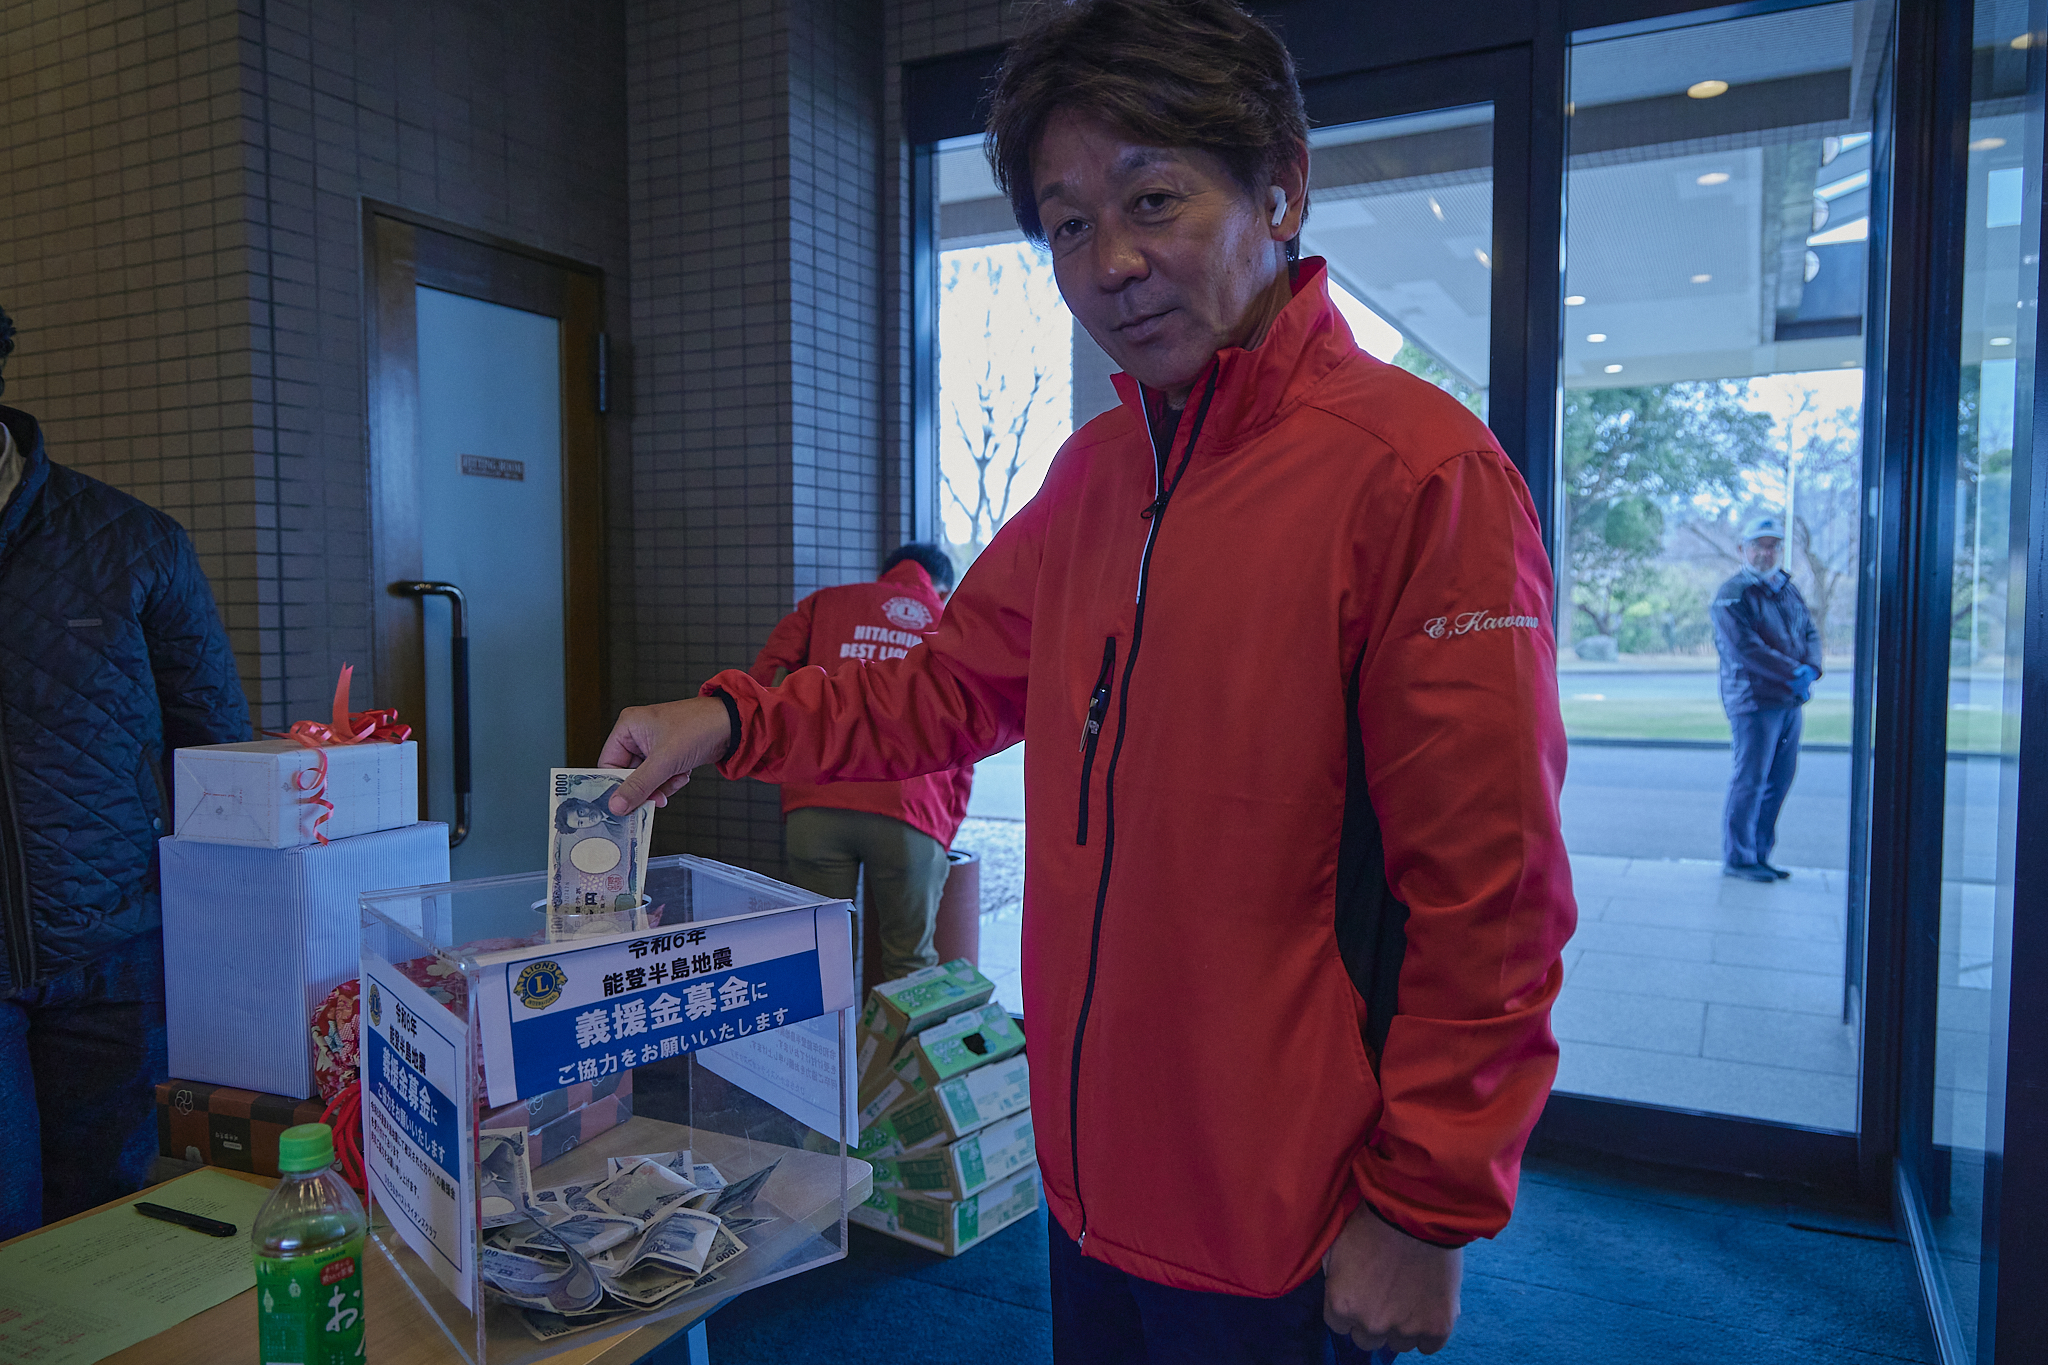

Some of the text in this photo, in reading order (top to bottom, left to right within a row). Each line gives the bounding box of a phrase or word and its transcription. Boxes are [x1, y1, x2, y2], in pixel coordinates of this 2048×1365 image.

[839, 643, 877, 659] BEST
[555, 774, 568, 797] 1000
[628, 928, 707, 959] 令和6年
[525, 962, 556, 975] LIONS
[535, 975, 549, 994] L
[602, 947, 733, 997] 能登半島地震
[395, 1002, 418, 1038] 令和6年
[575, 975, 768, 1049] 義援金募金に
[389, 1023, 427, 1076] 能登半島地震
[558, 1008, 789, 1085] ご協力をお願いいたします
[382, 1046, 438, 1126] 義援金募金に
[378, 1082, 446, 1164] ご協力をお願いいたします
[716, 1246, 740, 1263] 1000
